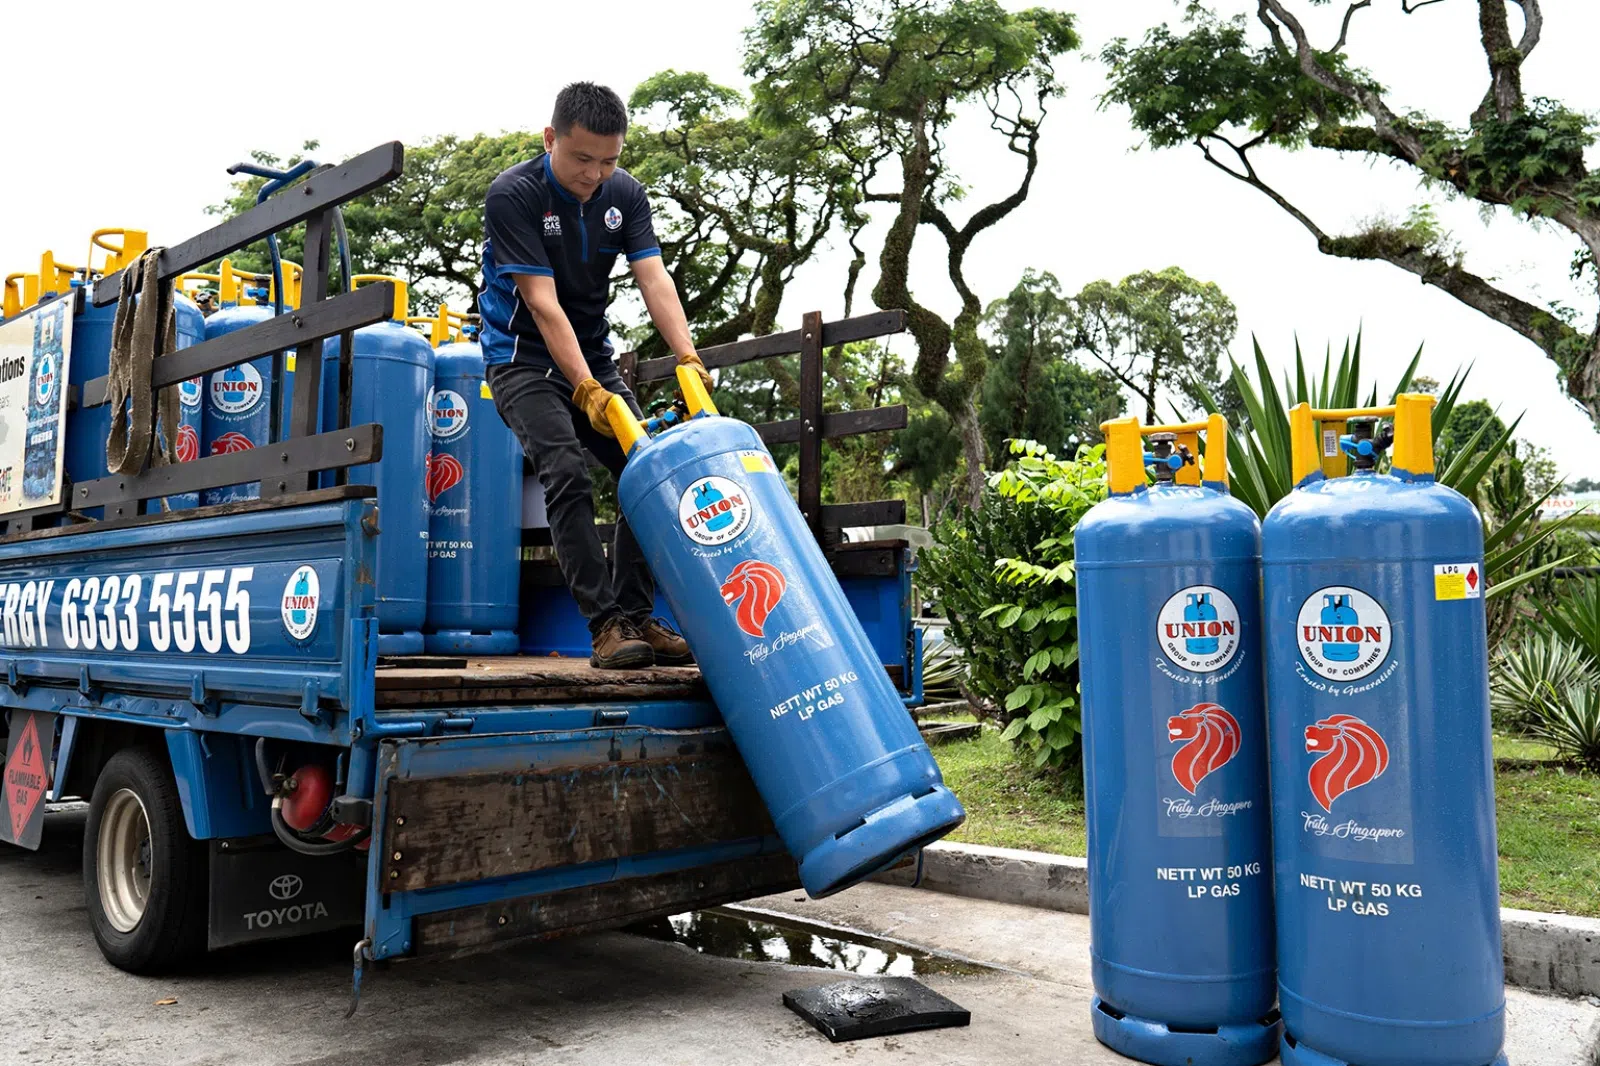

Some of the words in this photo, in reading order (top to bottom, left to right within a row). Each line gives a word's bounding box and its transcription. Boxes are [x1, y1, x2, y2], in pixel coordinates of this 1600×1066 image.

[0, 356, 25, 384] tions
[214, 382, 258, 392] UNION
[686, 494, 744, 529] UNION
[460, 541, 473, 549] KG
[61, 574, 142, 651] 6333
[148, 566, 254, 654] 5555
[285, 596, 316, 610] UNION
[1165, 621, 1235, 638] UNION
[1303, 626, 1382, 642] UNION
[744, 643, 769, 665] Truly
[1167, 642, 1188, 662] GROUP
[1205, 640, 1235, 667] COMPANIES
[1305, 646, 1324, 668] GROUP
[1343, 648, 1381, 676] COMPANIES
[1156, 657, 1190, 684] Trusted
[1192, 677, 1202, 687] by
[1205, 650, 1246, 685] Generations
[1295, 661, 1326, 691] Trusted
[1328, 685, 1340, 696] by
[1343, 660, 1399, 696] Generations
[770, 694, 800, 720] NETT
[802, 684, 823, 702] WT
[824, 678, 839, 692] 50
[839, 671, 858, 684] KG
[798, 706, 814, 721] LP
[817, 692, 845, 712] GAS
[8, 769, 42, 790] FLAMMABLE
[16, 789, 28, 806] GAS
[1162, 797, 1194, 818] Truly
[1198, 798, 1252, 817] Singapore
[16, 814, 21, 828] 2
[1301, 811, 1330, 836] Truly
[1333, 820, 1405, 842] Singapore
[1156, 868, 1196, 880] NETT
[1200, 868, 1223, 880] WT
[1227, 865, 1242, 879] 50
[1244, 862, 1260, 876] KG
[1188, 886, 1207, 898] LP
[1210, 884, 1240, 897] GAS
[1300, 873, 1336, 892] NETT
[1340, 880, 1366, 895] WT
[1371, 884, 1391, 897] 50
[1396, 884, 1422, 898] KG
[244, 901, 328, 930] TOYOTA
[1327, 897, 1347, 911] LP
[1352, 901, 1390, 916] GAS
